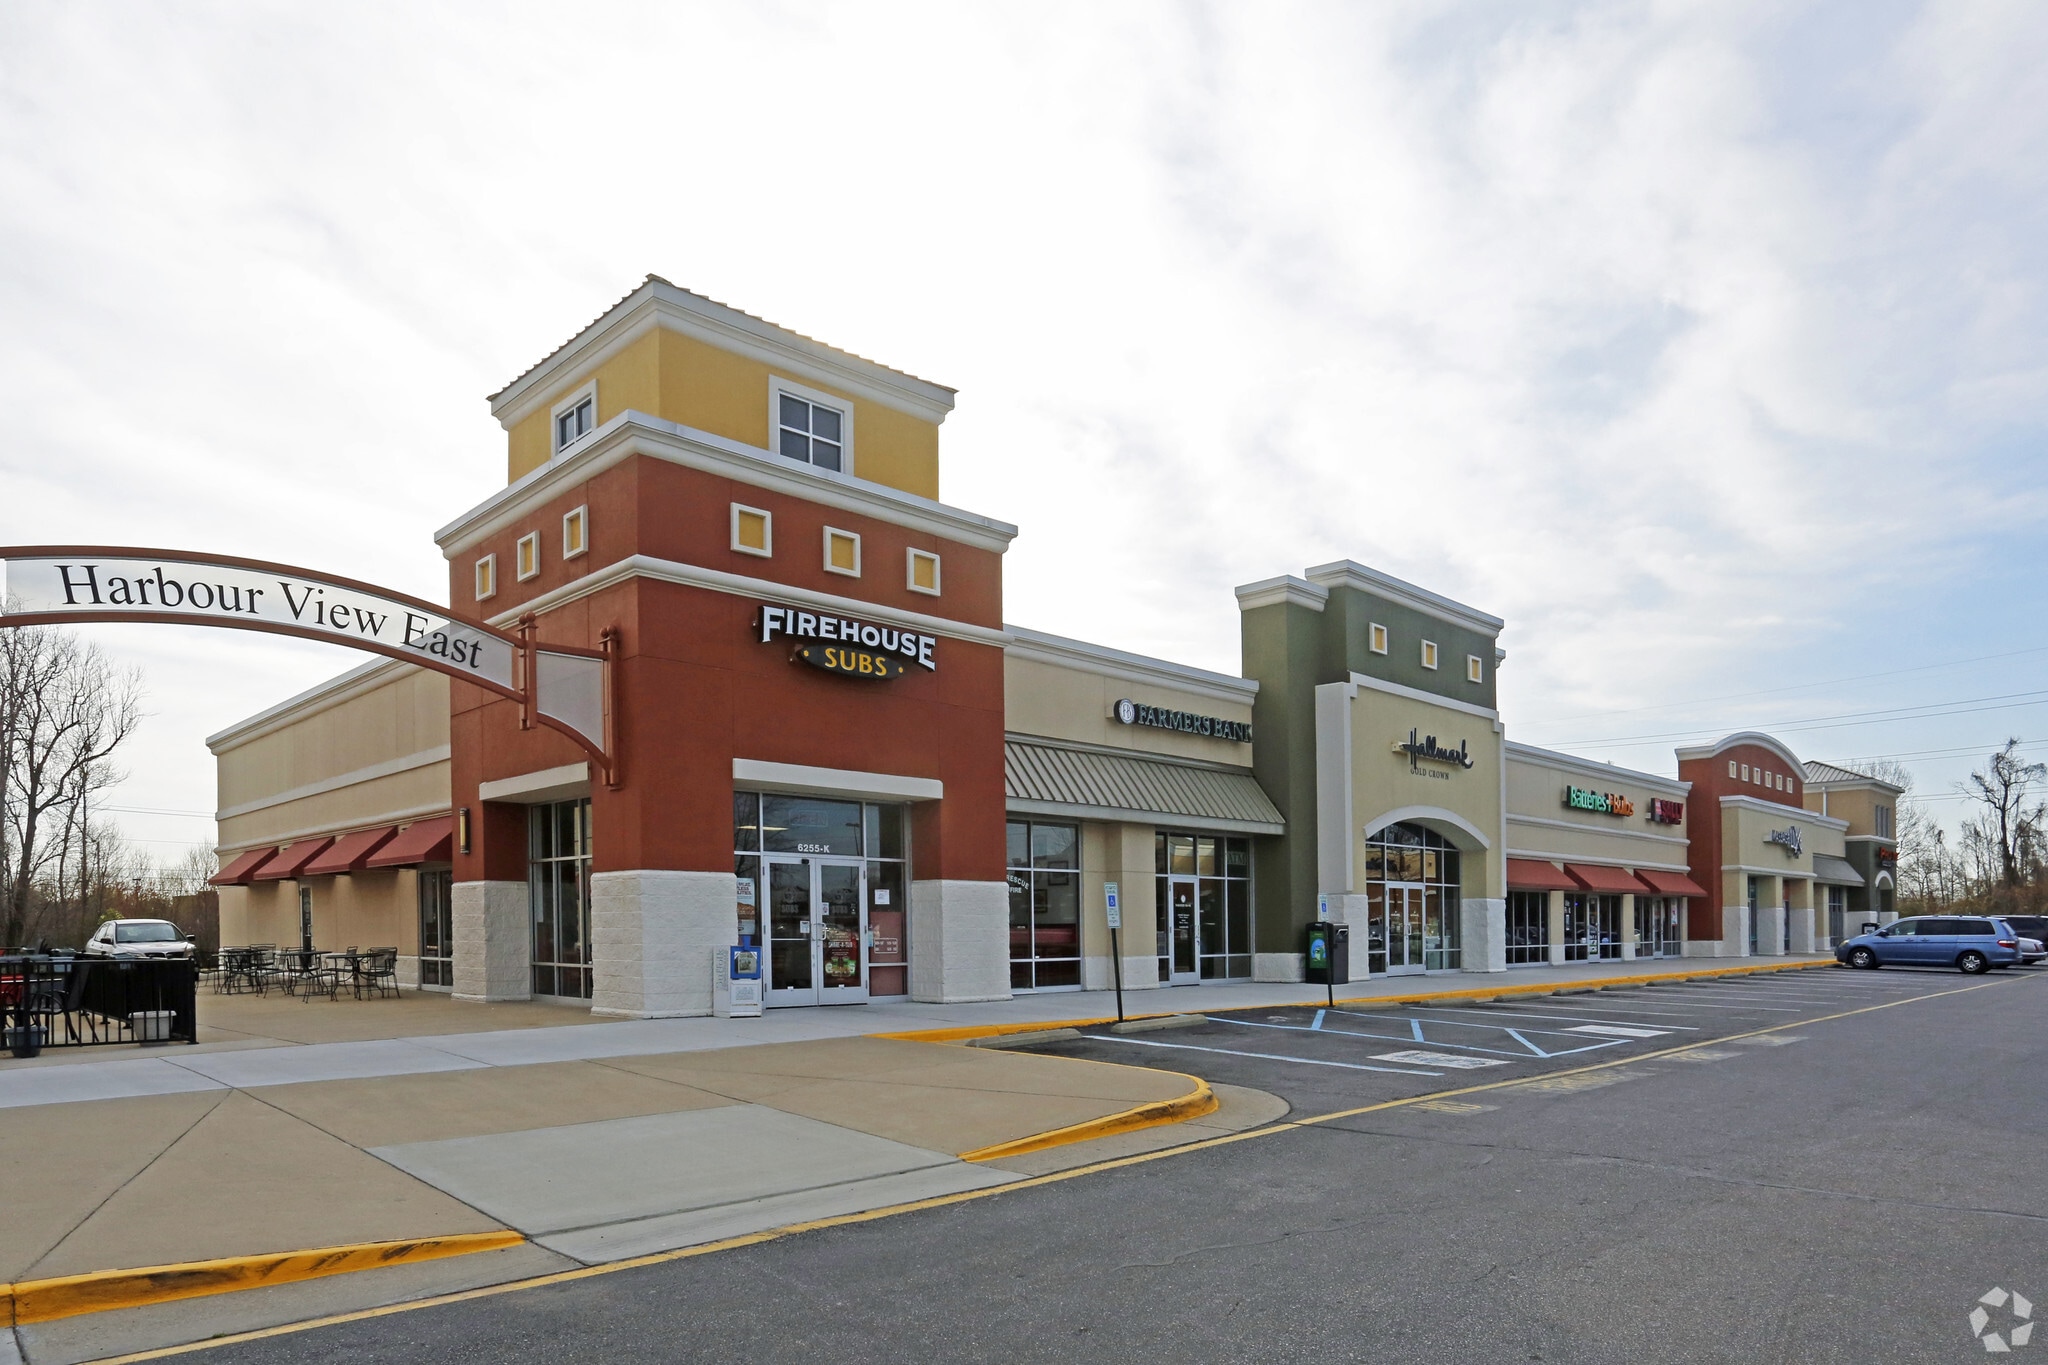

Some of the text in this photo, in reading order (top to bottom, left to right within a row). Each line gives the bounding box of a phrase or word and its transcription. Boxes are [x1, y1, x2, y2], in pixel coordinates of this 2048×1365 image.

[54, 565, 484, 670] Harbour View East
[761, 605, 937, 672] FIREHOUSE
[824, 647, 888, 676] SUBS
[1137, 704, 1211, 736] FARMERS
[1402, 727, 1474, 769] Hallmark
[1410, 767, 1450, 780] GOLD CROWN
[797, 843, 830, 853] 6255-K
